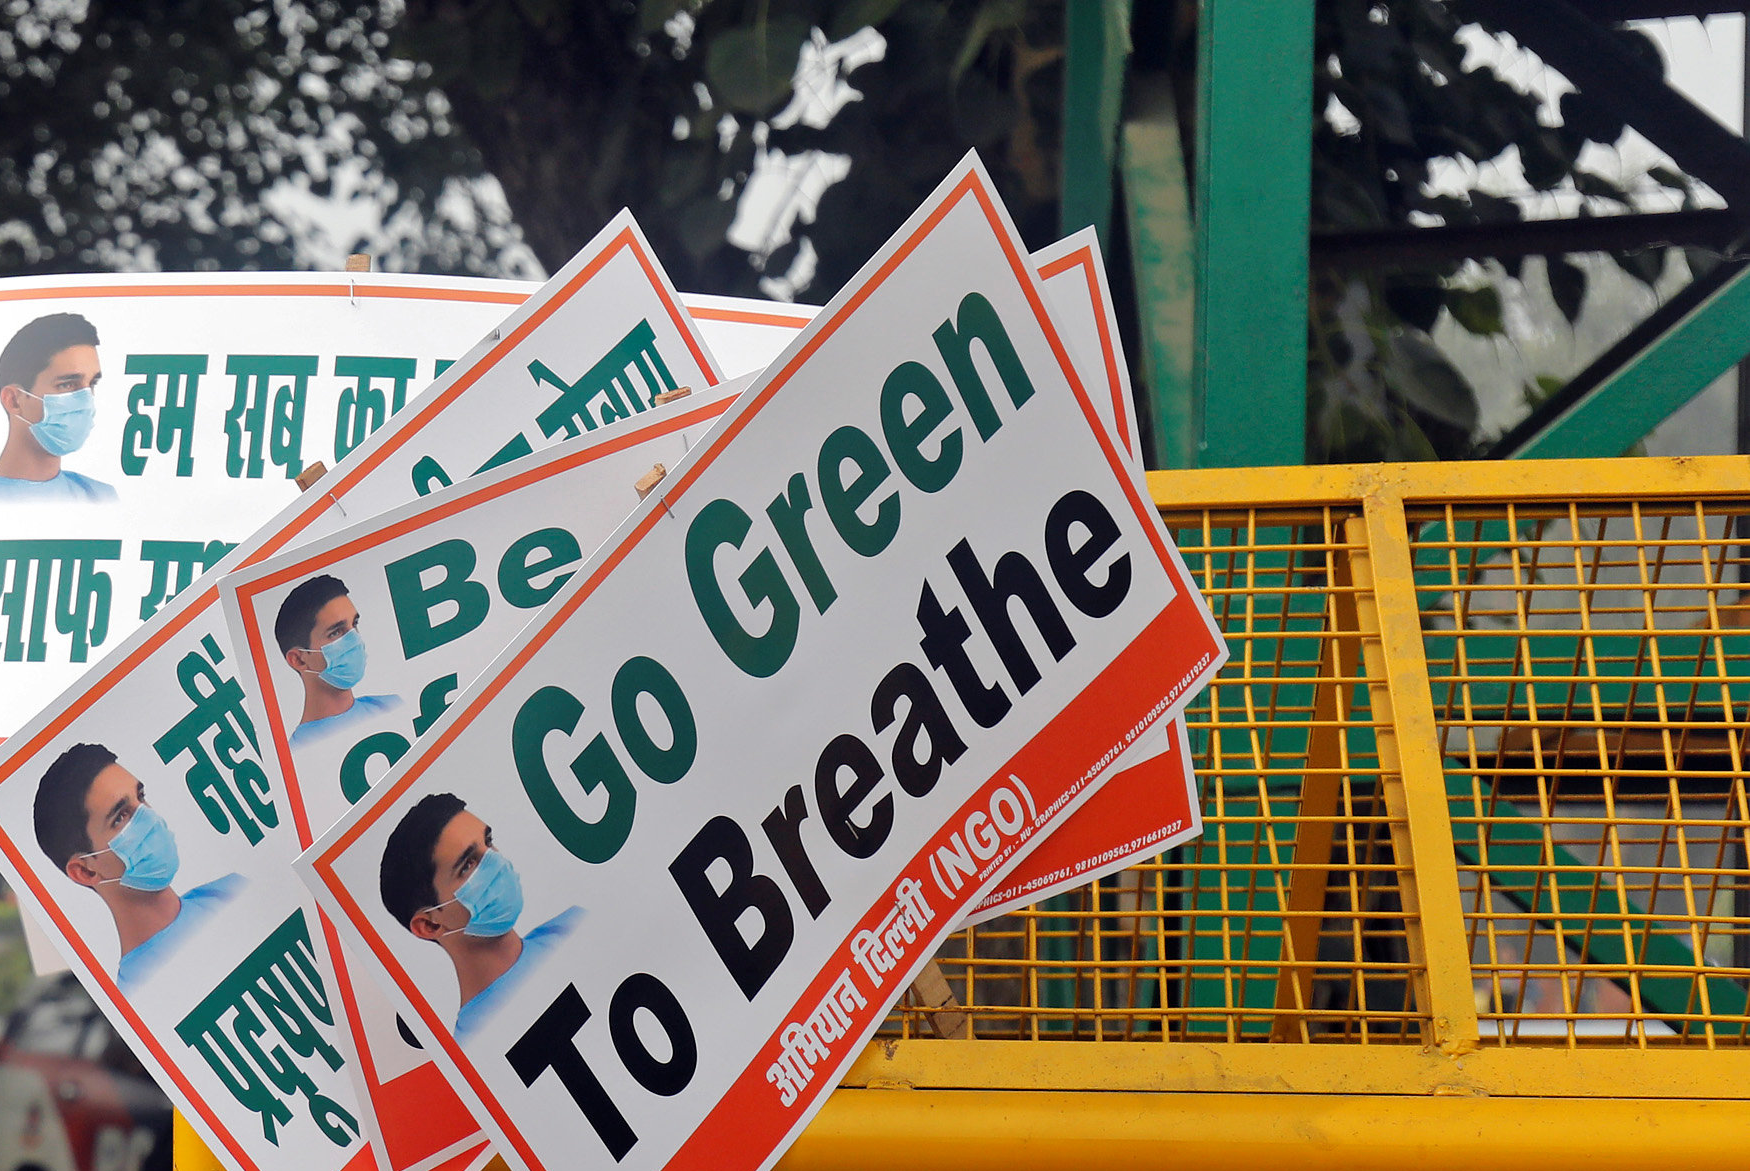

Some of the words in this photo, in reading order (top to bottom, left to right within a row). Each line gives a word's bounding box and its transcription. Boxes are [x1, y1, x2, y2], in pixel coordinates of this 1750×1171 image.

[120, 354, 208, 477] हम
[224, 355, 318, 479] सब
[512, 655, 697, 865] Go
[685, 292, 1035, 678] Green
[384, 527, 583, 660] Be
[505, 972, 698, 1164] To
[670, 490, 1132, 1001] Breathe
[766, 967, 868, 1108] अभियान
[850, 877, 936, 988] दिल्ली
[929, 774, 1038, 899] (NGO)
